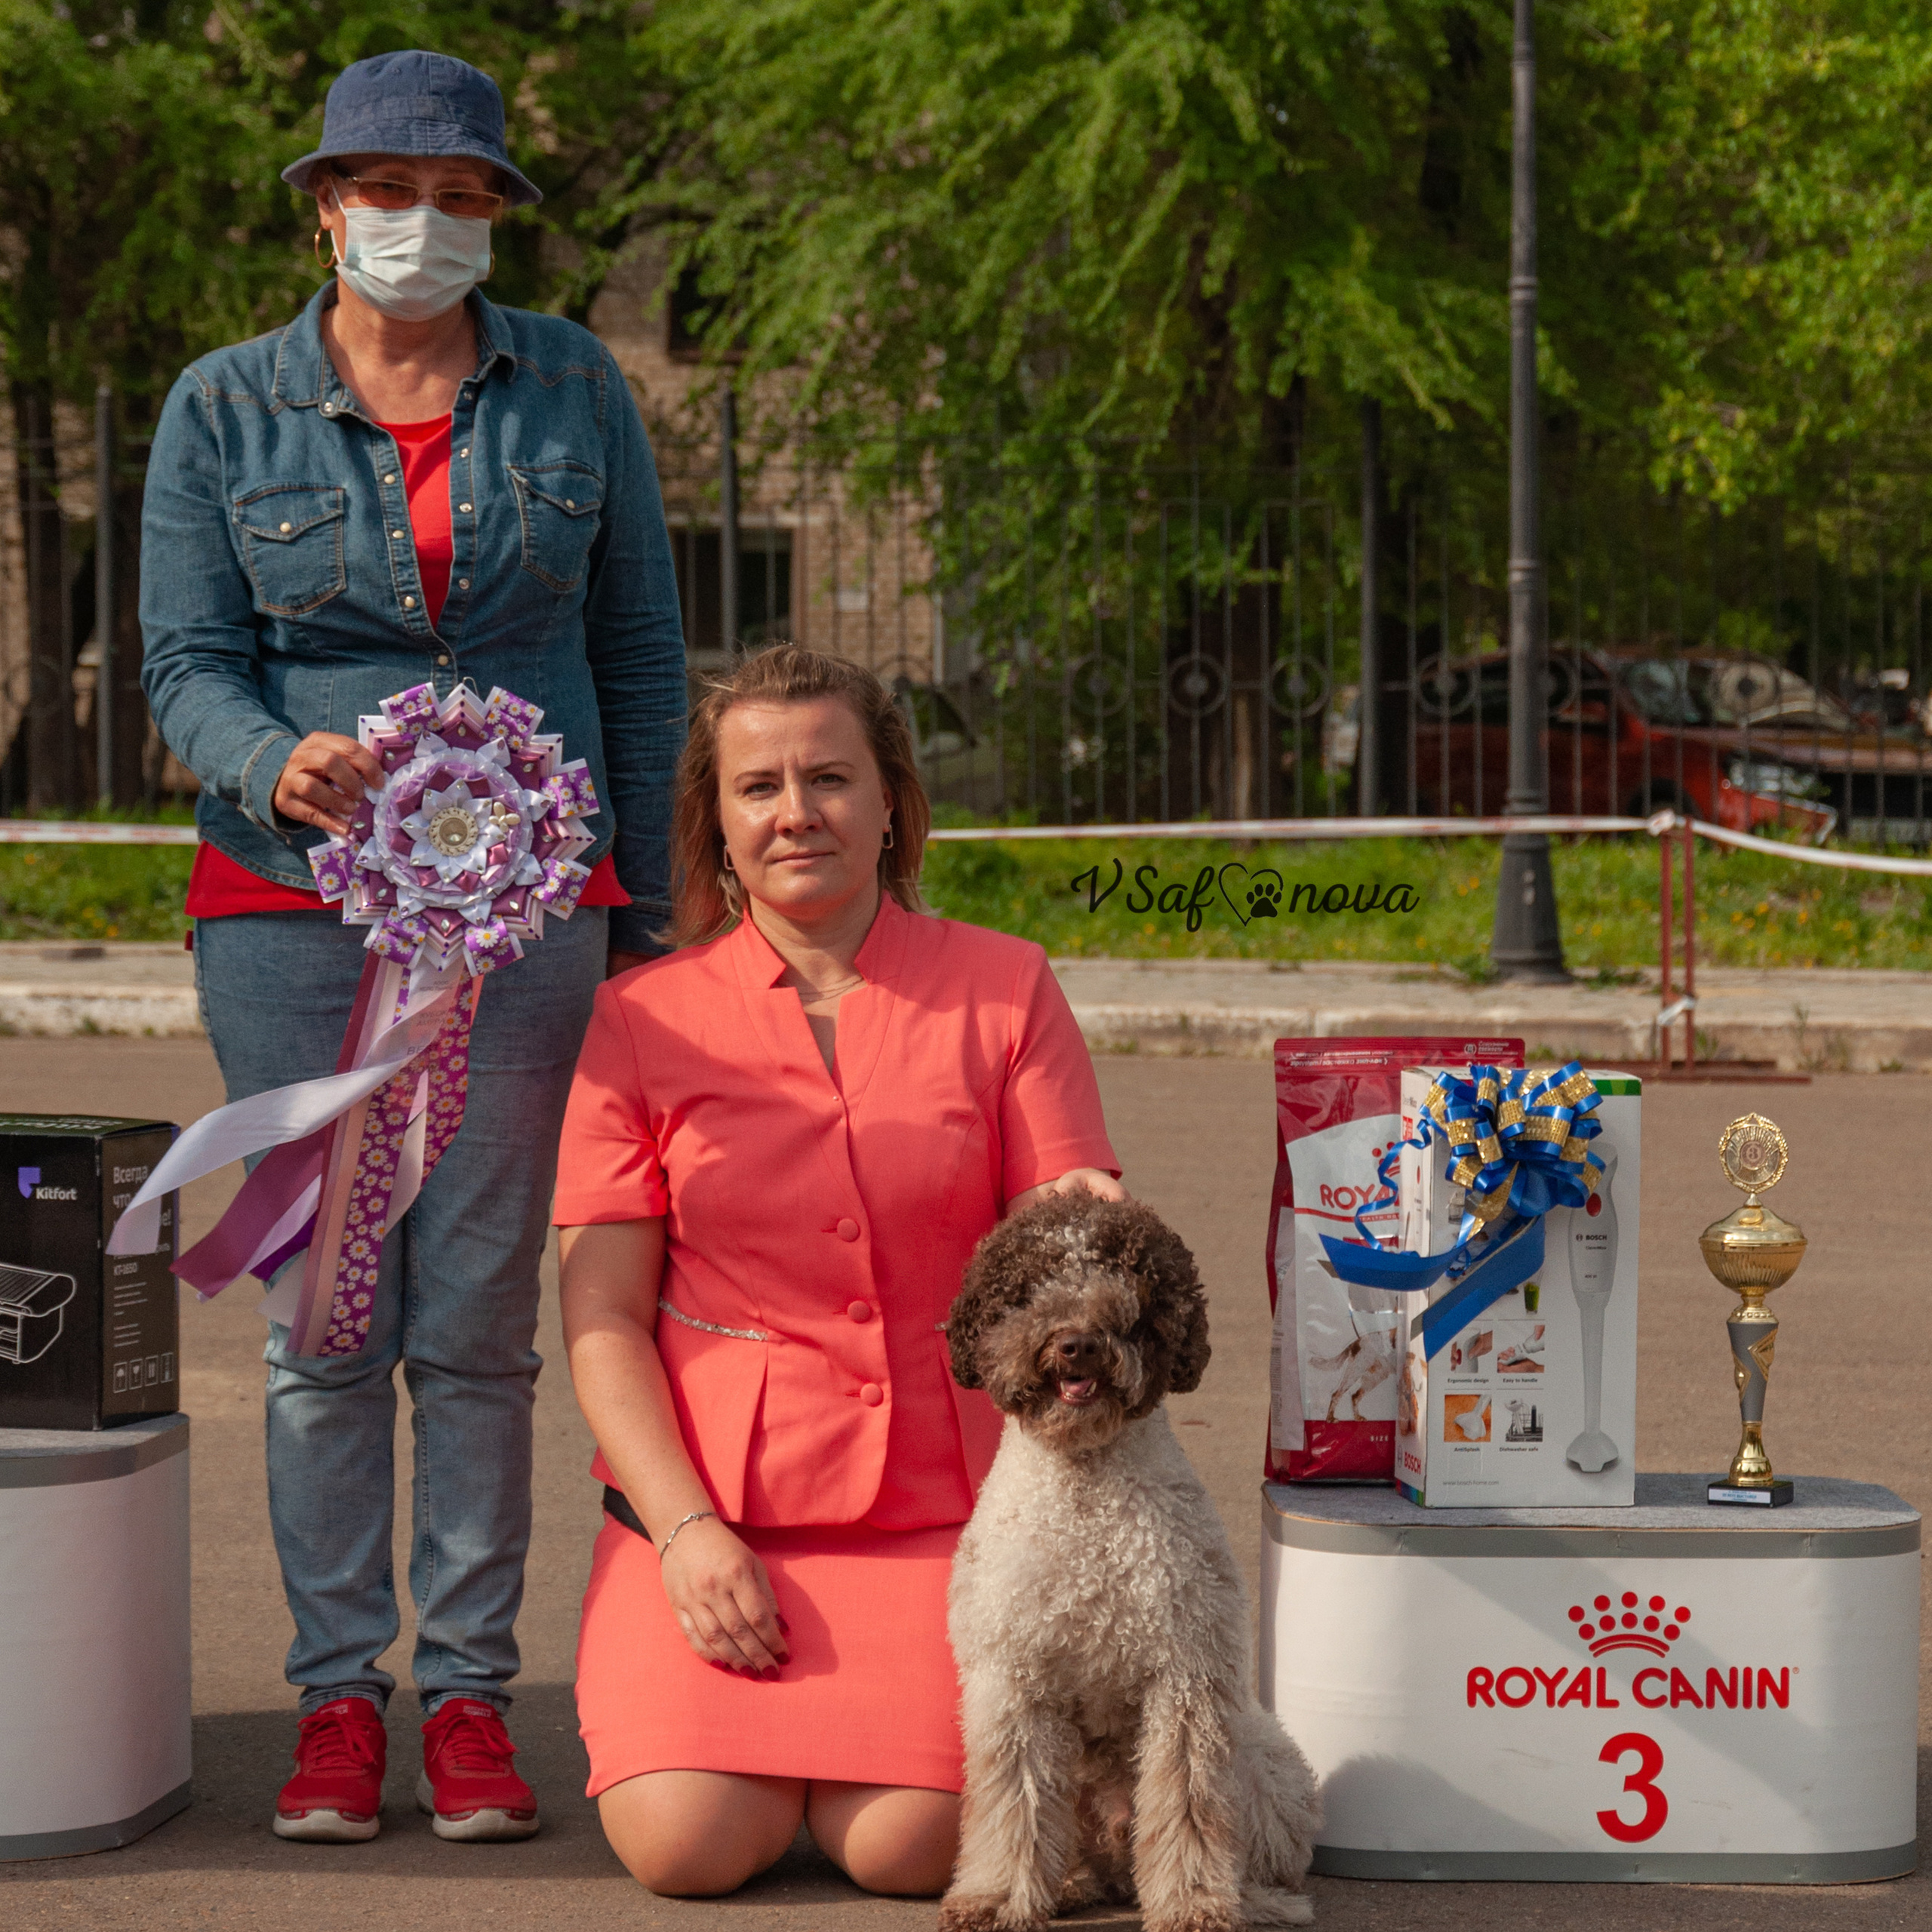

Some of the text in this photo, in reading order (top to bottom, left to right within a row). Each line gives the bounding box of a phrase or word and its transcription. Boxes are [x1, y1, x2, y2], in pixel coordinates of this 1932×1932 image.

[112, 1166, 148, 1185] Всегда
[35, 1187, 77, 1201] Kitfort
[1404, 1452, 1421, 1475] BOSCH
[1467, 1666, 1620, 1709] ROYAL
[1596, 1732, 1669, 1843] 3
